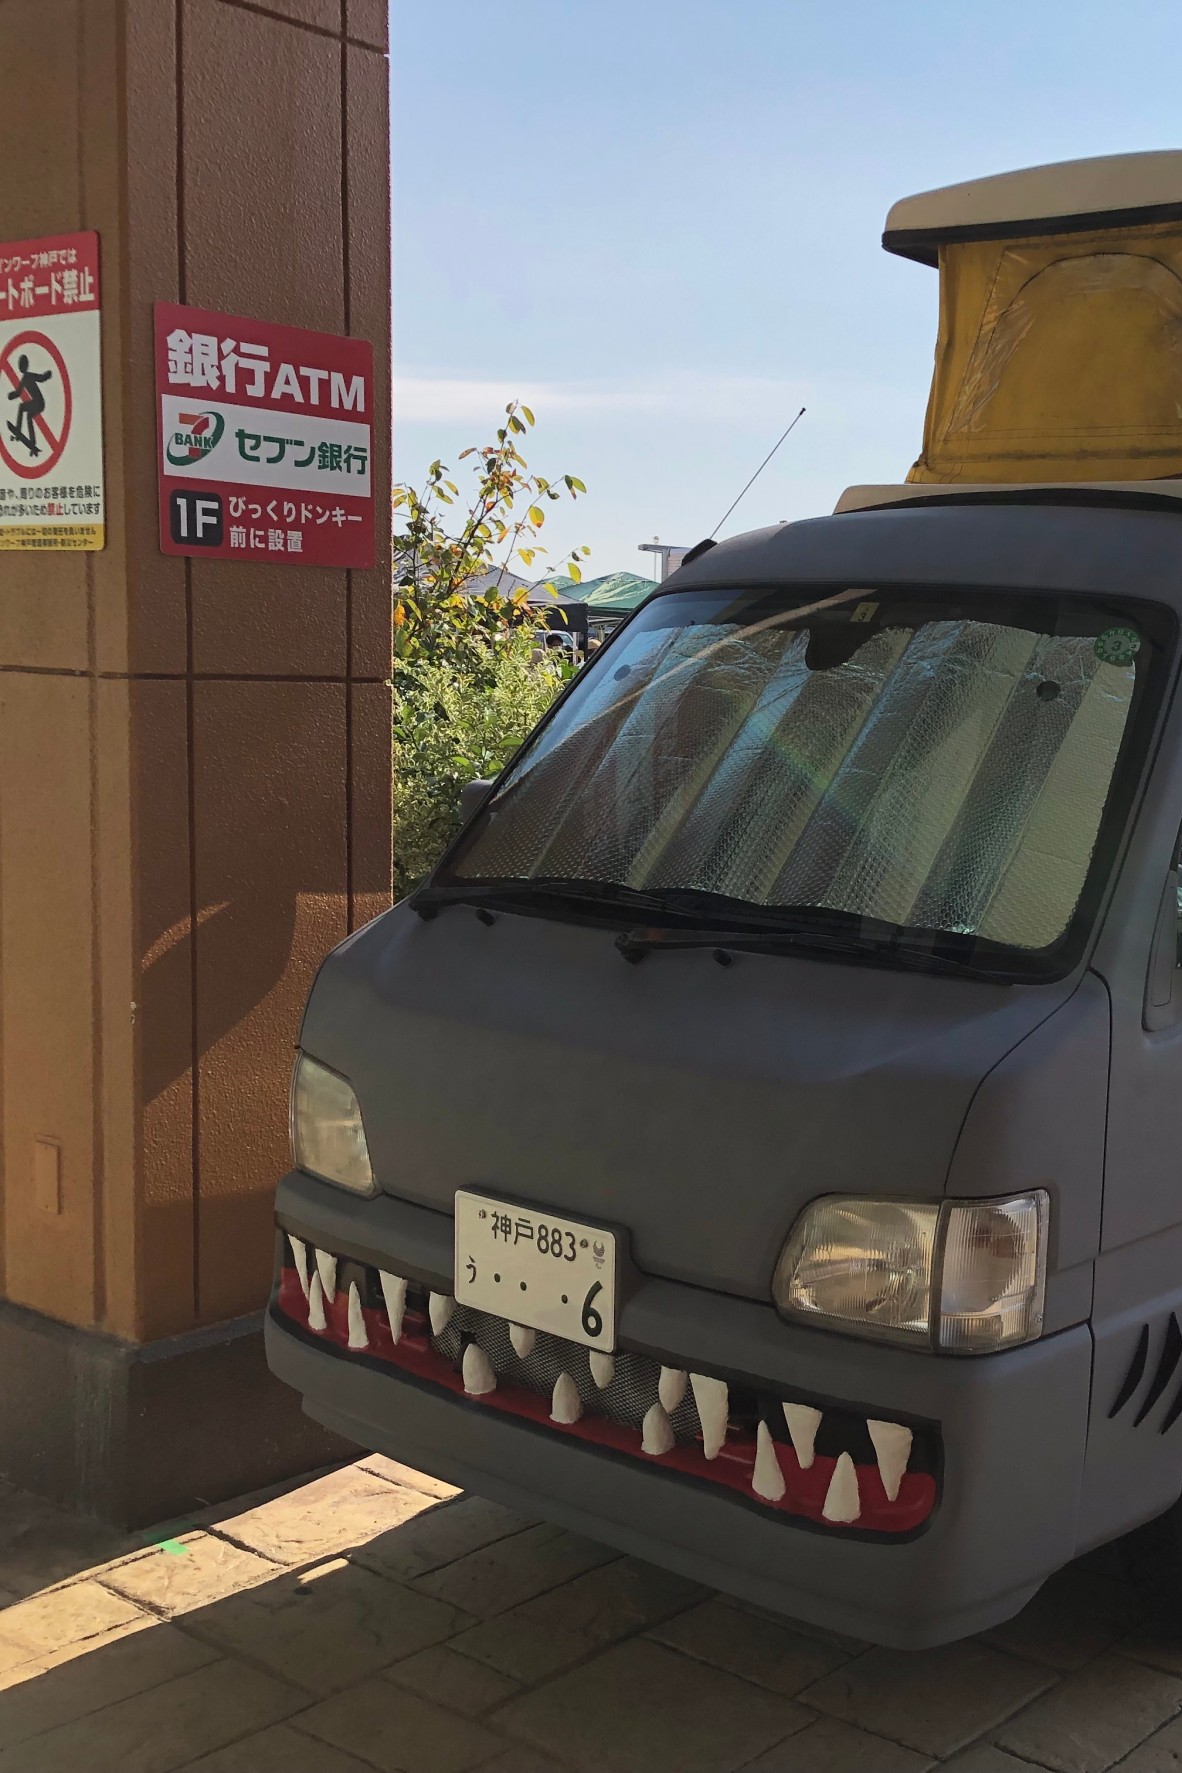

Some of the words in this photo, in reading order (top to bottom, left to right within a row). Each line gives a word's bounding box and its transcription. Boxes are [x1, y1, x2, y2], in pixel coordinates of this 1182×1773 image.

[166, 329, 365, 412] 銀行ATM
[175, 433, 214, 449] BANK
[235, 429, 368, 475] セブン銀行
[176, 497, 219, 538] 1F
[229, 496, 363, 527] びっくりドンキー
[229, 525, 303, 553] 前に設置
